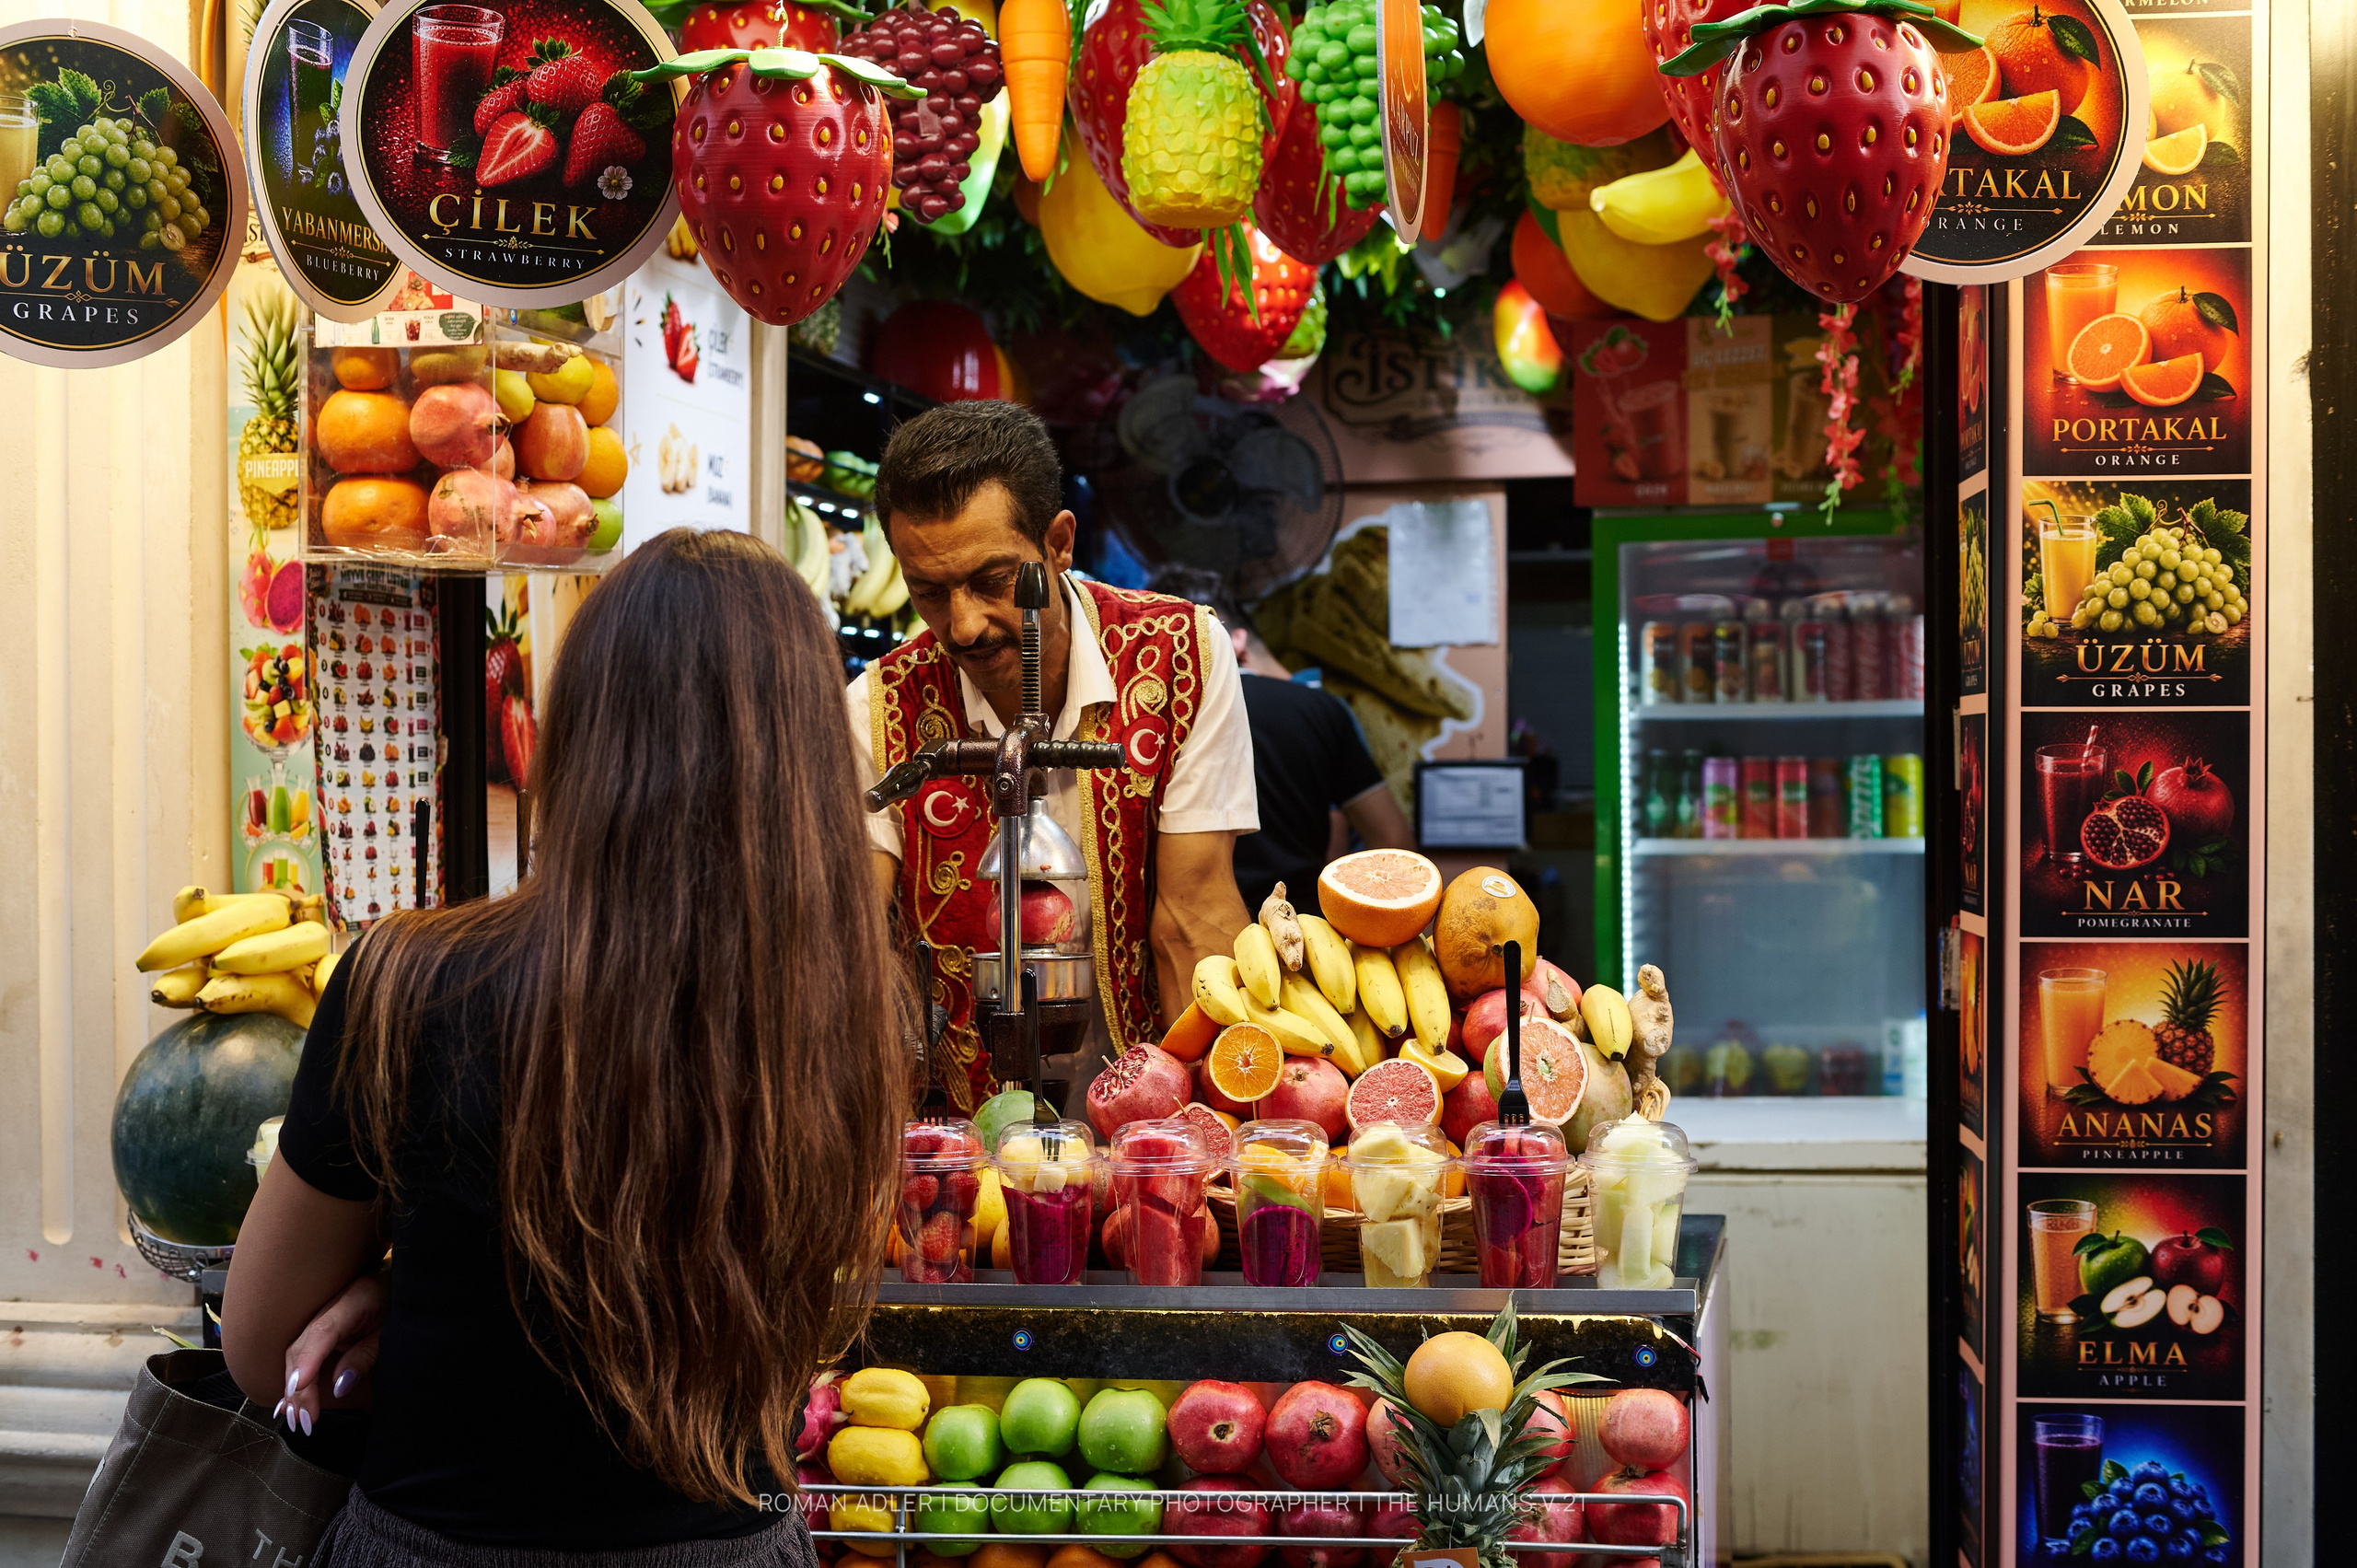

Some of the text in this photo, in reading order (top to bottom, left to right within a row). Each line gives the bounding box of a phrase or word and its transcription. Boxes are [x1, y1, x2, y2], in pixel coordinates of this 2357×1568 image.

[1939, 168, 2081, 200] TAKAL
[429, 189, 598, 240] ÇİLEK
[1925, 216, 2024, 231] RANGE
[2100, 223, 2179, 236] LEMON
[0, 243, 166, 296] ÜZÜM
[307, 254, 379, 281] BLUEBERRY
[445, 248, 585, 270] STRAWBERRY
[13, 302, 139, 324] GRAPES
[2052, 416, 2227, 442] PORTAKAL
[2095, 454, 2180, 466] ORANGE
[2075, 638, 2207, 672] ÜZÜM
[2092, 683, 2186, 697] GRAPES
[2083, 880, 2186, 910] NAR
[2078, 918, 2192, 928] POMEGRANATE
[2056, 1112, 2213, 1139] ANANAS
[2083, 1150, 2185, 1159] PINEAPPLE
[2077, 1341, 2189, 1365] ELMA
[2098, 1375, 2167, 1387] APPLE
